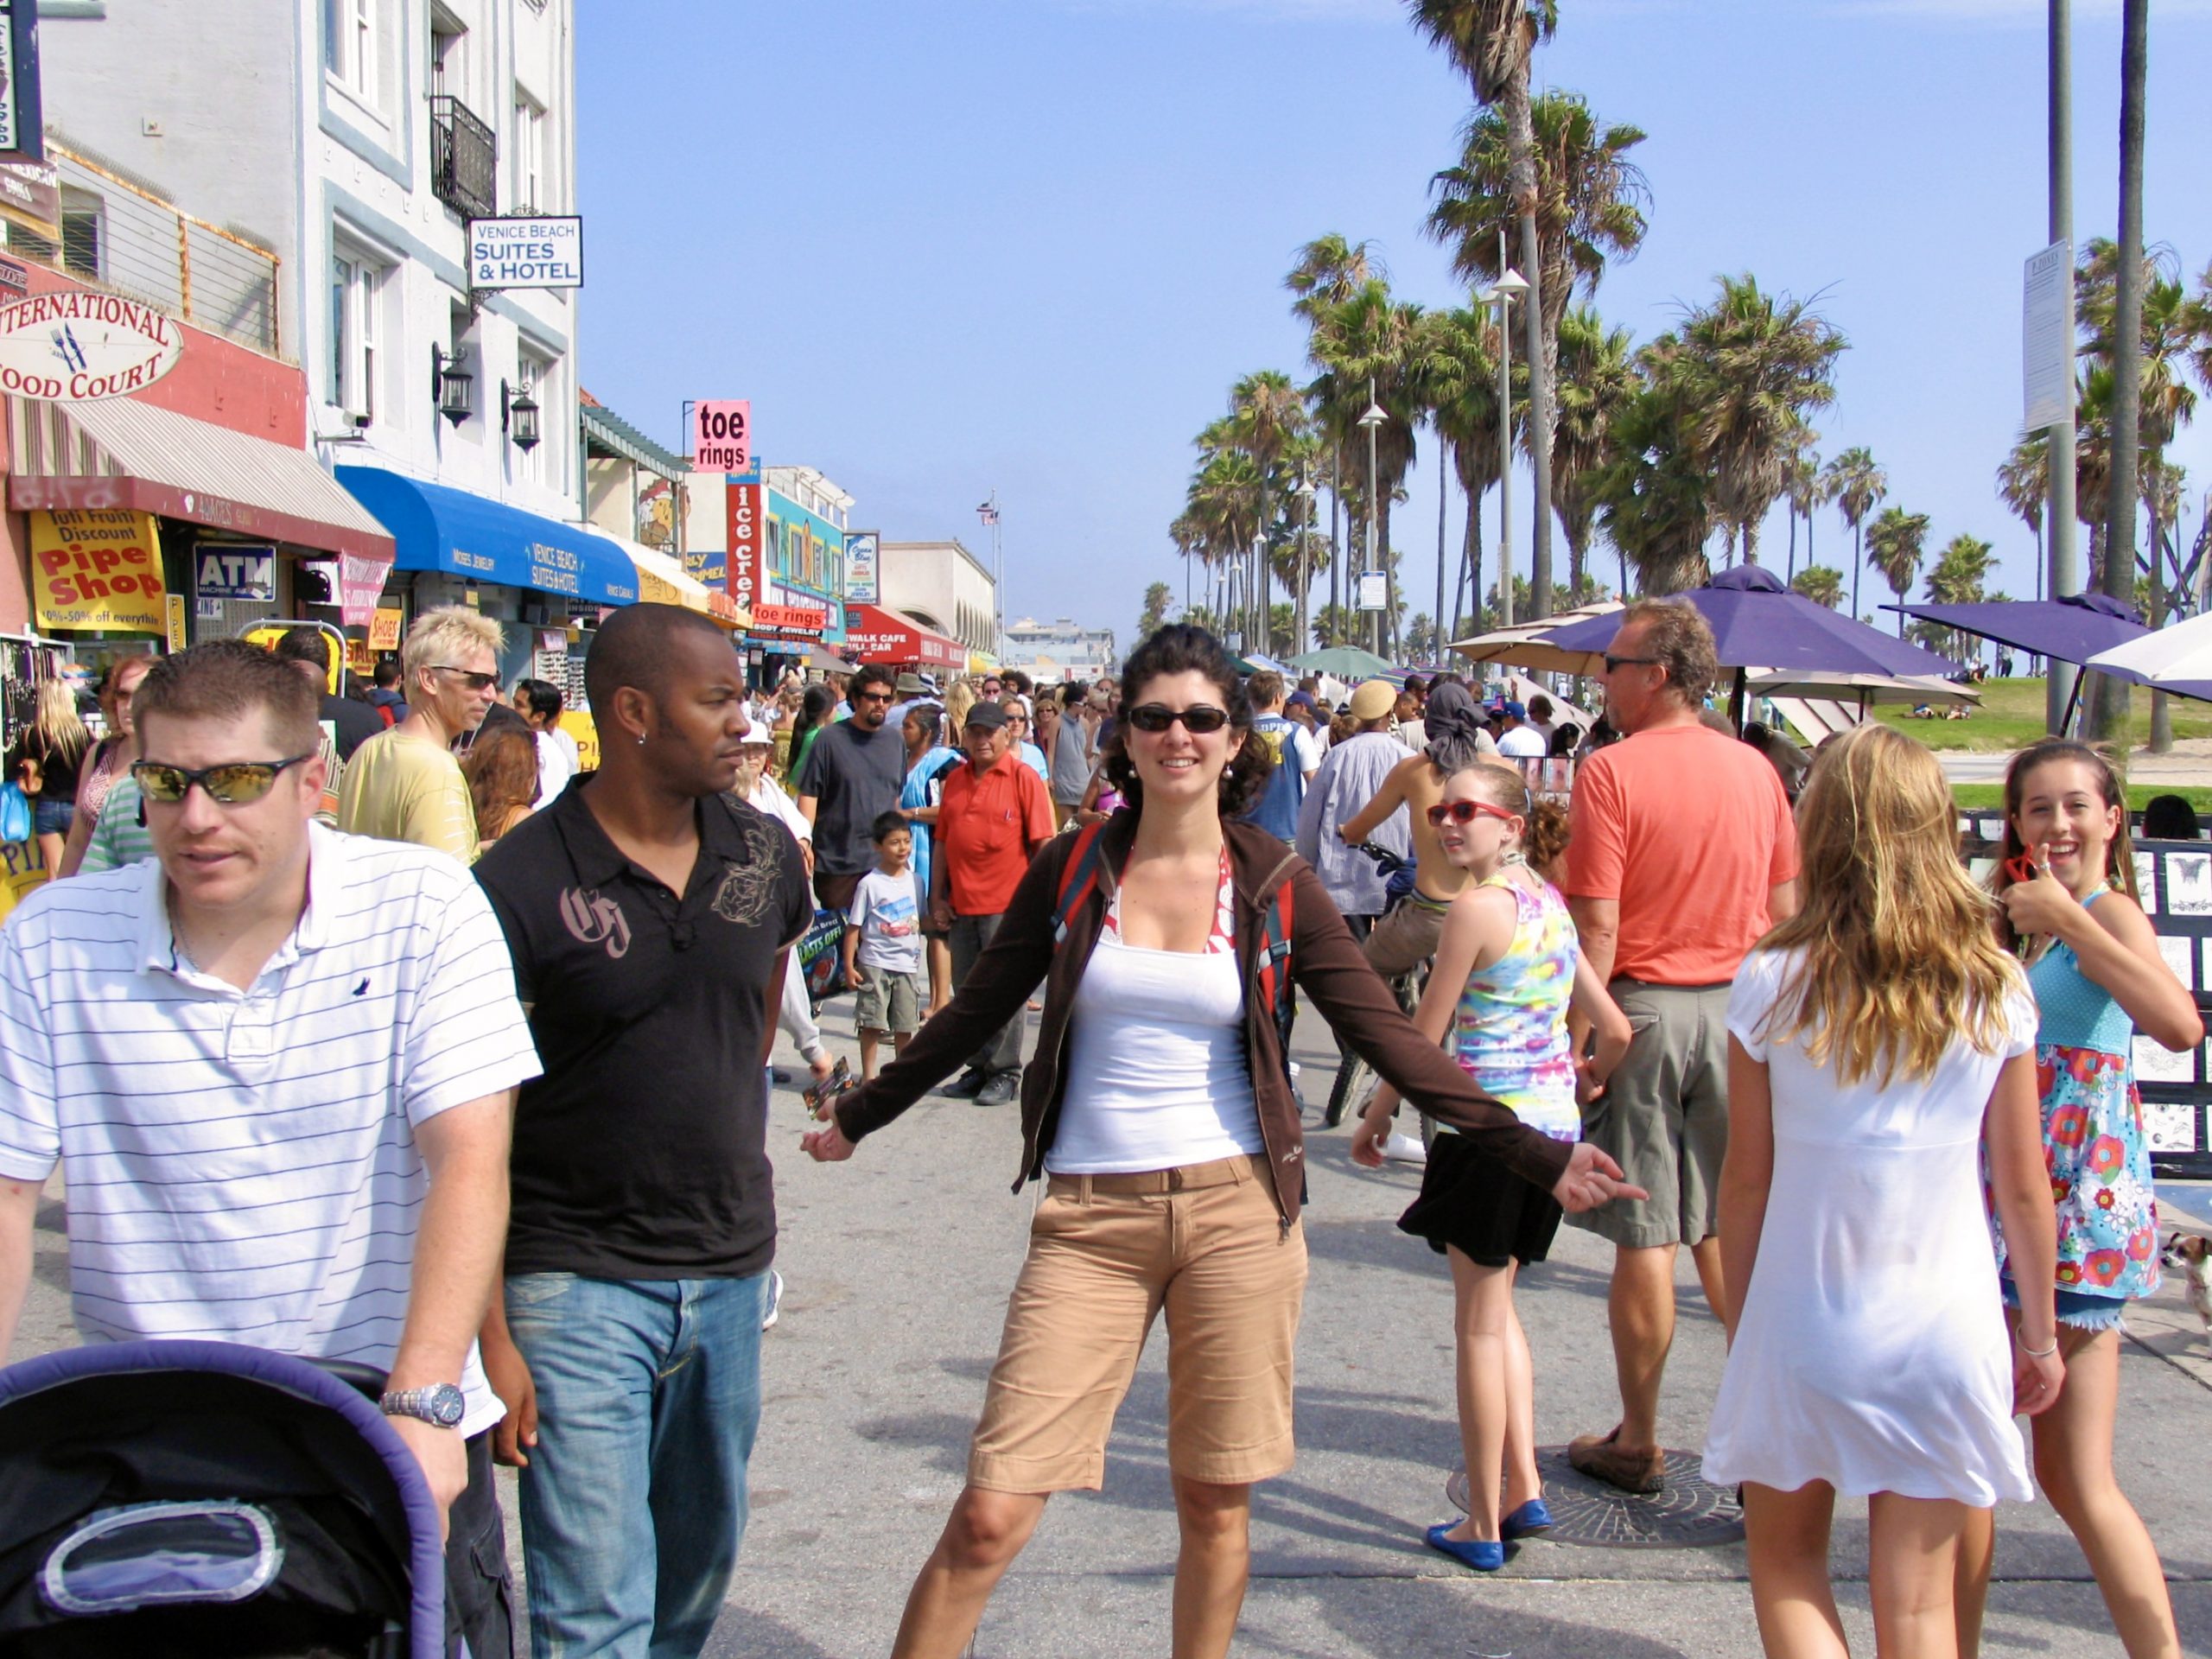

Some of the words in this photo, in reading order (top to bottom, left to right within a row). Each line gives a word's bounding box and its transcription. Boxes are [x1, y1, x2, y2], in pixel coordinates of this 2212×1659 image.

[478, 226, 526, 238] VENICE
[530, 225, 575, 238] BEACH
[474, 243, 555, 260] SUITES
[480, 264, 494, 280] &
[501, 262, 578, 279] HOTEL
[0, 364, 61, 397] OOD
[70, 352, 162, 398] COURT
[701, 404, 744, 439] toe
[700, 442, 744, 470] rings
[735, 486, 753, 540] ice
[59, 526, 137, 543] Discount
[37, 543, 147, 576] Pipe
[532, 543, 555, 566] VENICE
[556, 549, 578, 572] BEACH
[200, 556, 273, 587] ATM
[532, 566, 553, 588] SUITES
[559, 573, 580, 594] HOTEL
[48, 572, 162, 606] Shop
[199, 586, 232, 594] MACHINE
[96, 610, 111, 622] off
[113, 613, 163, 626] everythin
[373, 616, 397, 638] SHOES
[754, 607, 779, 620] toe
[785, 610, 822, 626] rings
[779, 626, 820, 637] JEWELRY
[880, 634, 906, 643] CAFE
